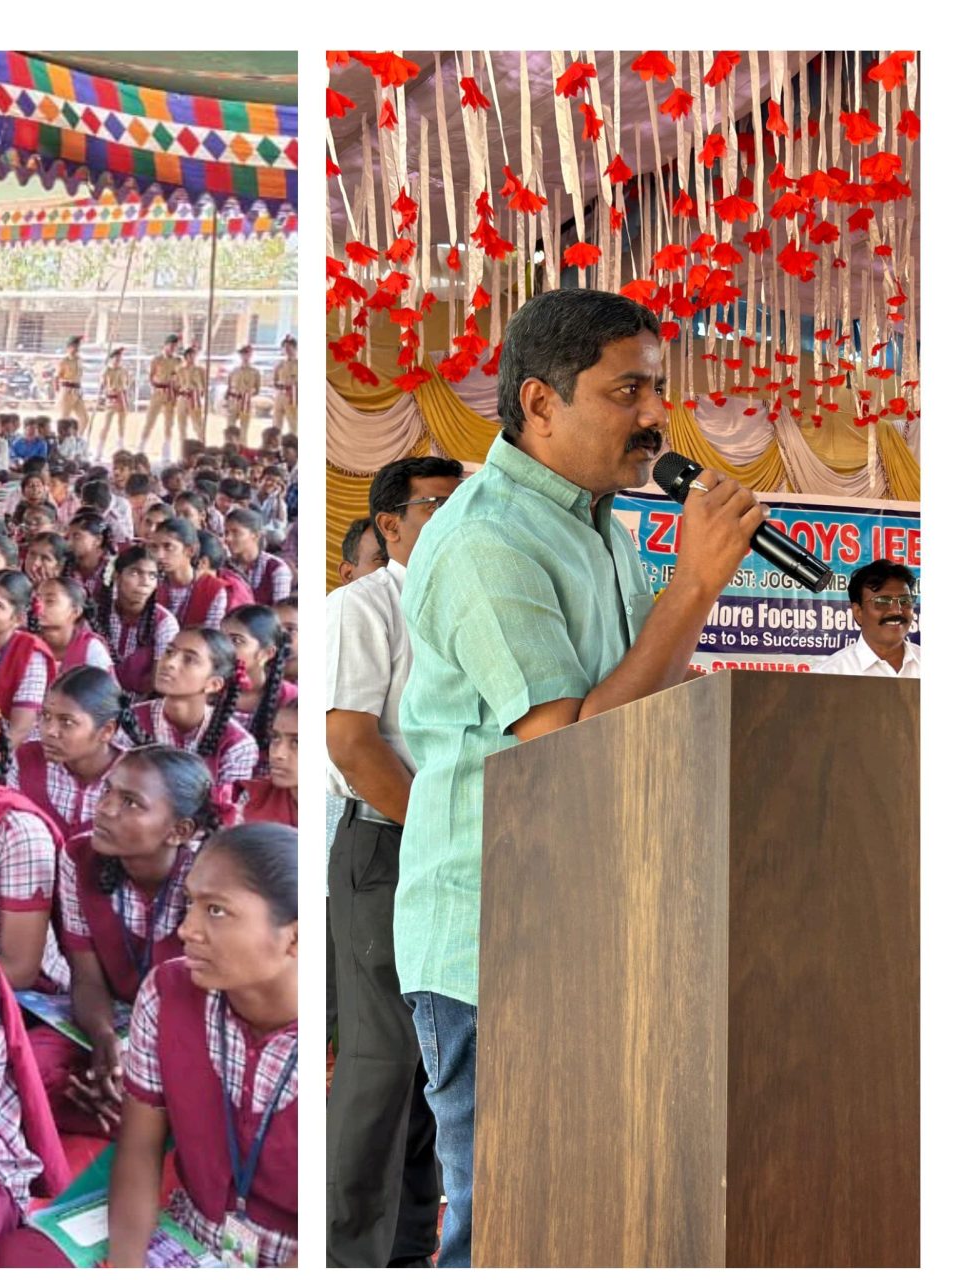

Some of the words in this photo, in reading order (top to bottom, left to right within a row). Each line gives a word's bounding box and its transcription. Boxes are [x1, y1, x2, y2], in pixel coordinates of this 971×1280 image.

[757, 603, 817, 630] Focus
[720, 630, 736, 645] to
[740, 631, 759, 646] be
[762, 632, 840, 649] Successful
